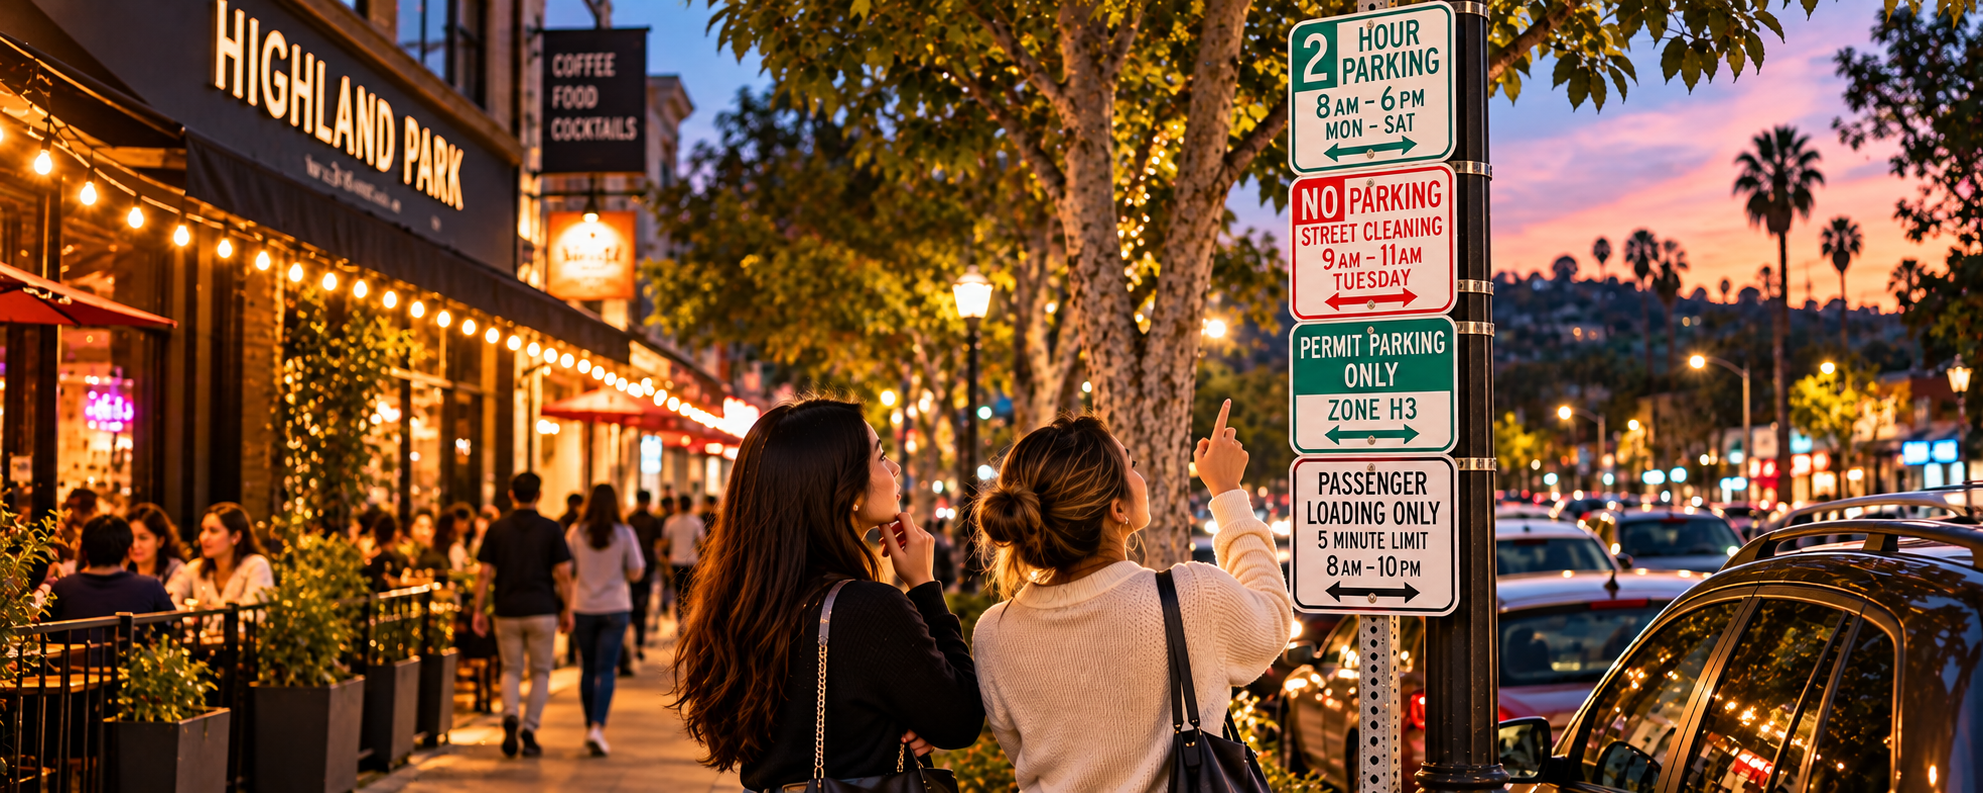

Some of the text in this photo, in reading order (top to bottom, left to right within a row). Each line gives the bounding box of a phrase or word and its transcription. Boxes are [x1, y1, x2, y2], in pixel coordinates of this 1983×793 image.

[1358, 19, 1420, 52] HOUR
[553, 53, 615, 76] COFFEE
[1304, 33, 1327, 83] 2
[1343, 47, 1439, 85] PARKING
[215, 0, 396, 173] HIGHLAND
[404, 116, 463, 210] PARK
[553, 86, 598, 109] FOOD
[552, 117, 636, 140] COCKTAILS
[1325, 118, 1362, 140] MON
[1385, 113, 1415, 134] SAT
[1301, 180, 1441, 221] NO PARKING
[1301, 216, 1442, 247] STREET CLEANING
[1333, 267, 1413, 291] TUESDAY
[1301, 329, 1445, 359] PERMIT PARKING
[1345, 362, 1398, 387] ONLY
[1328, 398, 1416, 421] ZONE H3
[1319, 471, 1427, 495] PASSENGER
[1308, 501, 1440, 525] LOADING ONLY
[1318, 531, 1428, 549] 5 MINUTE LIMIT
